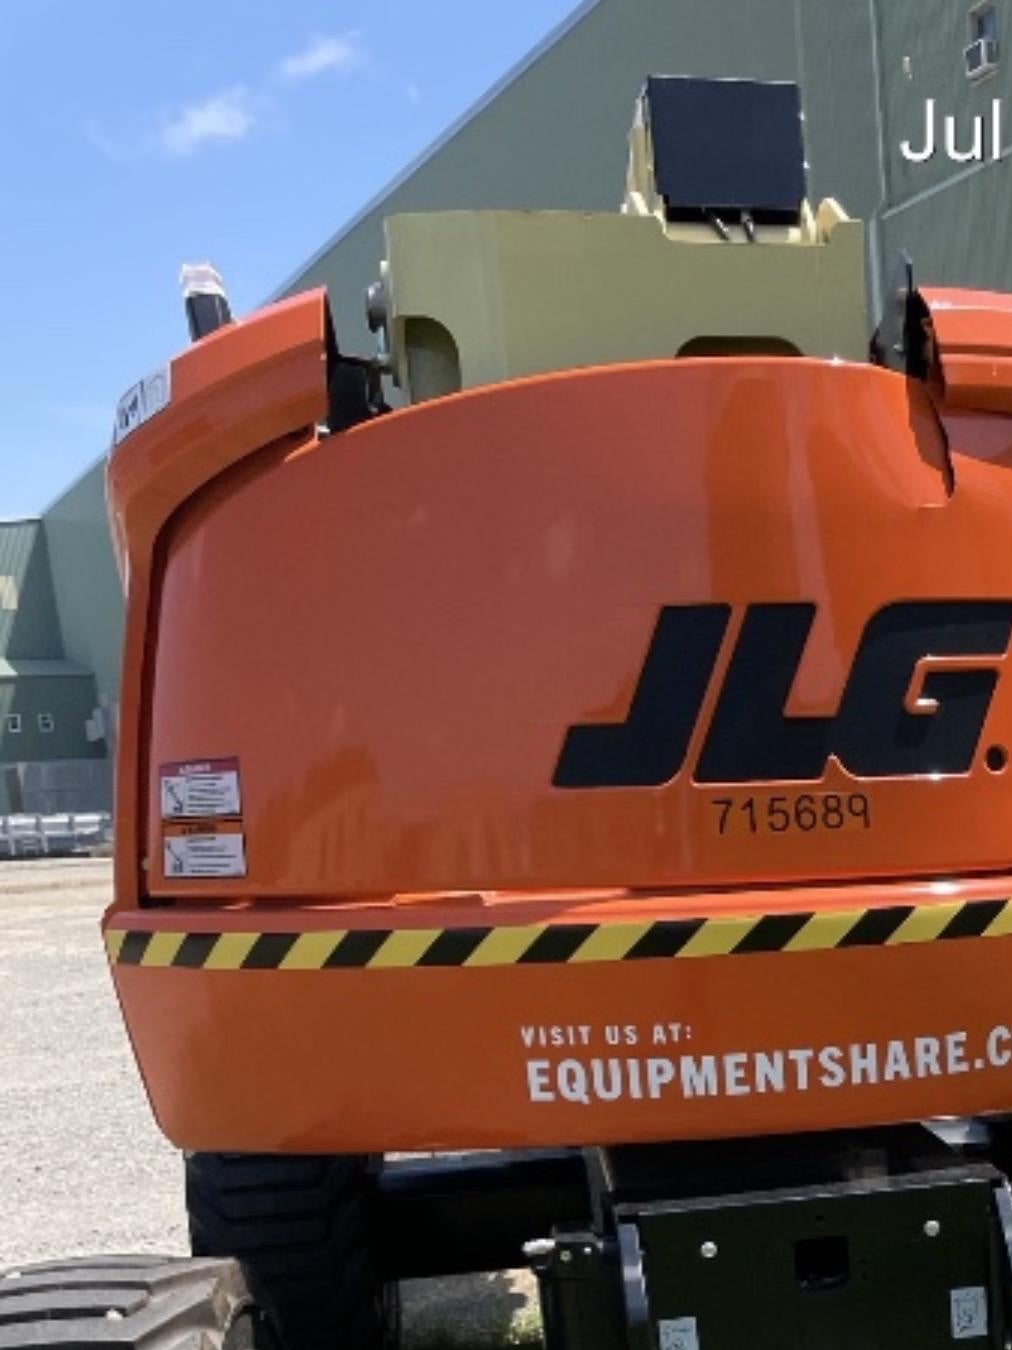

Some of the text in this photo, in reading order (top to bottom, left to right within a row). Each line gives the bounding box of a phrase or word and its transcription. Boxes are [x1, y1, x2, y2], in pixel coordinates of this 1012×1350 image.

[713, 795, 872, 835] 715689
[521, 1022, 693, 1048] VISIT US AT:
